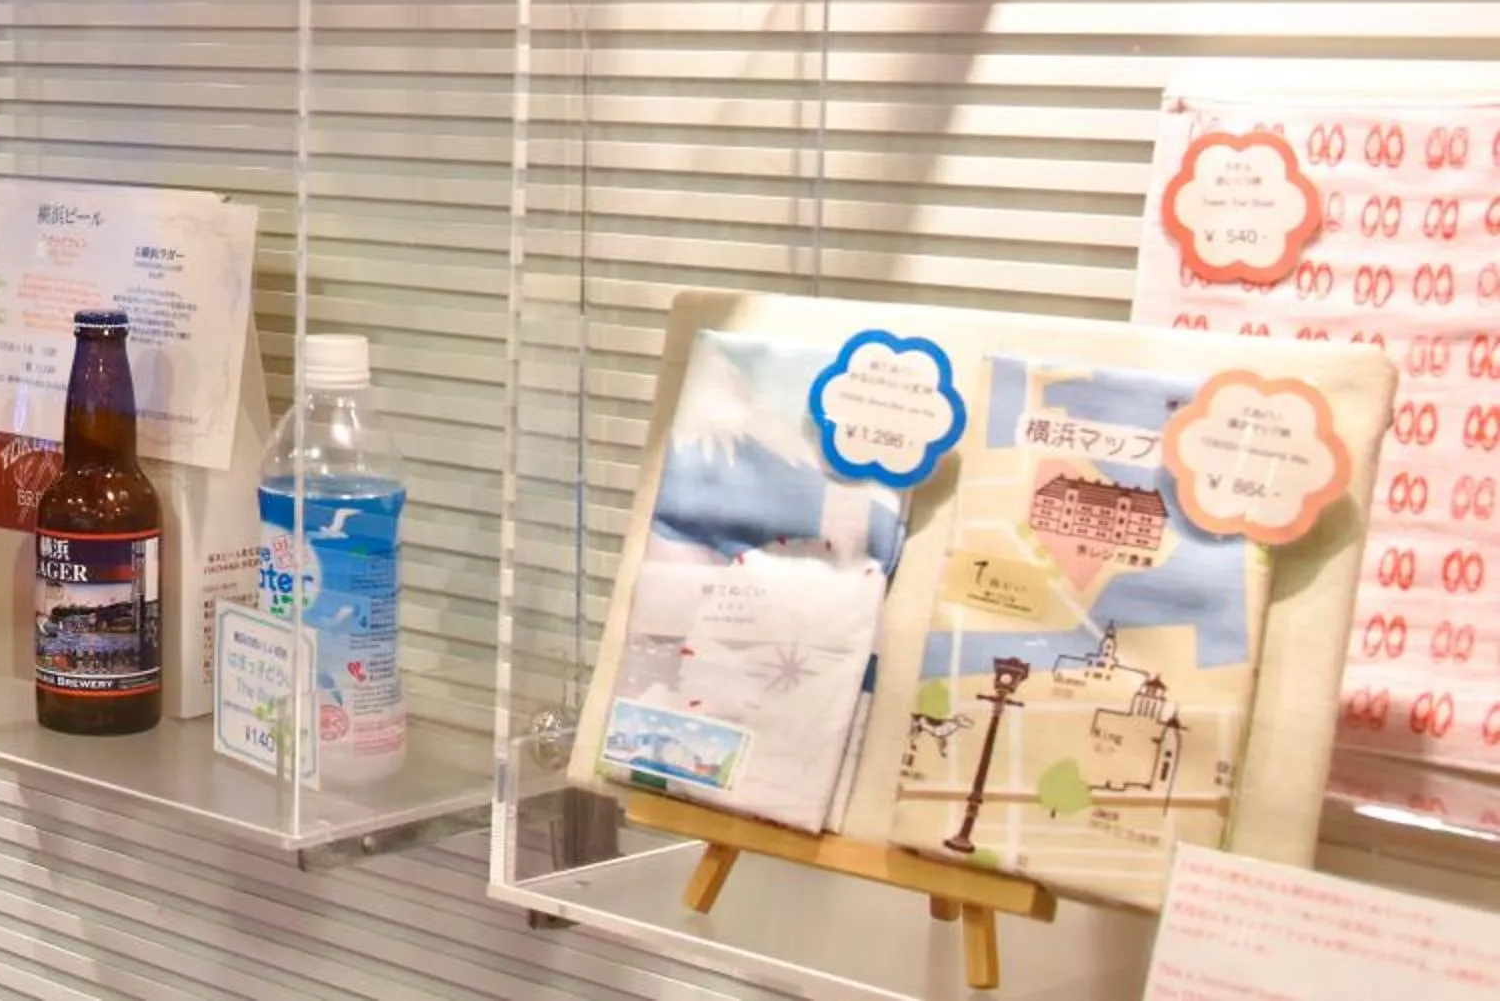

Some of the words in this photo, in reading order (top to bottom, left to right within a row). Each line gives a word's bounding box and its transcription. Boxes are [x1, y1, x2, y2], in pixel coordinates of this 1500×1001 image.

[37, 203, 104, 226] 横浜ビール
[37, 562, 89, 582] AGER
[56, 675, 114, 689] BREWERY
